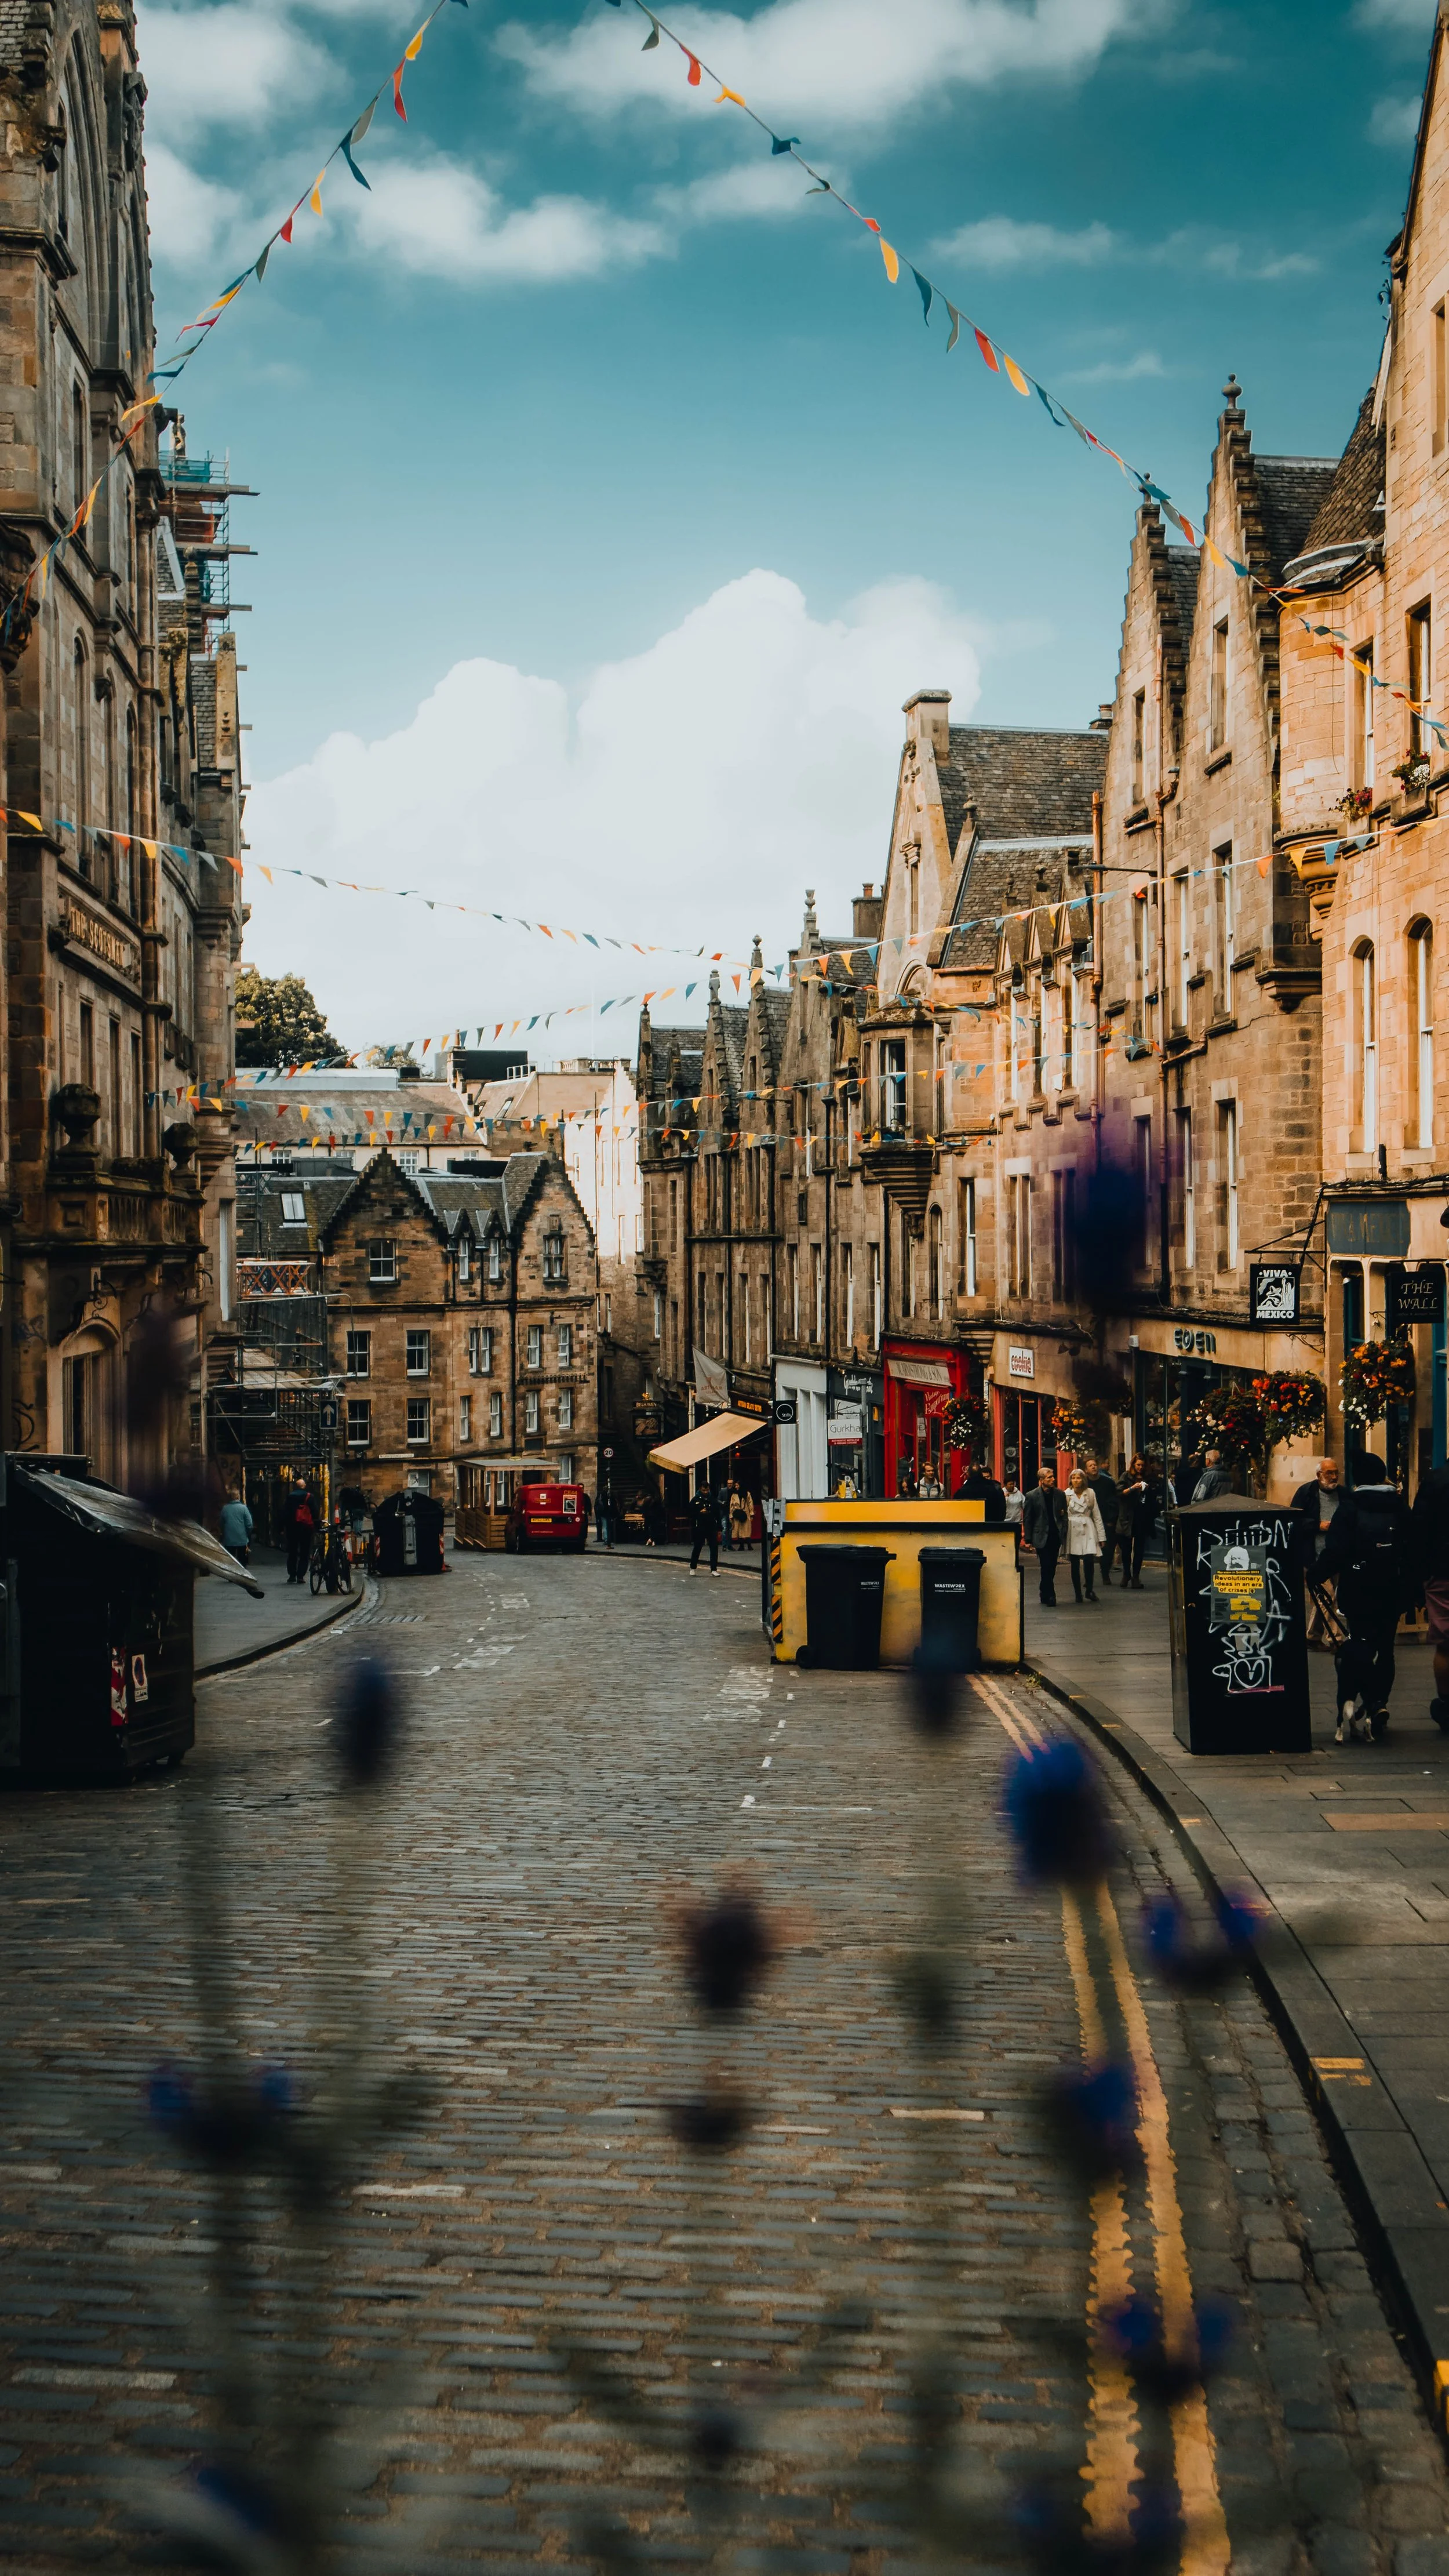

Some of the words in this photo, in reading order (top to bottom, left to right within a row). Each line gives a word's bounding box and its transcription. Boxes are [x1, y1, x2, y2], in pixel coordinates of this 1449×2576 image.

[70, 907, 87, 939] THE
[1401, 1280, 1433, 1294] THE
[1398, 1298, 1438, 1310] WALL
[1256, 1310, 1294, 1319] MEXICO
[830, 1424, 861, 1433] Gurkha
